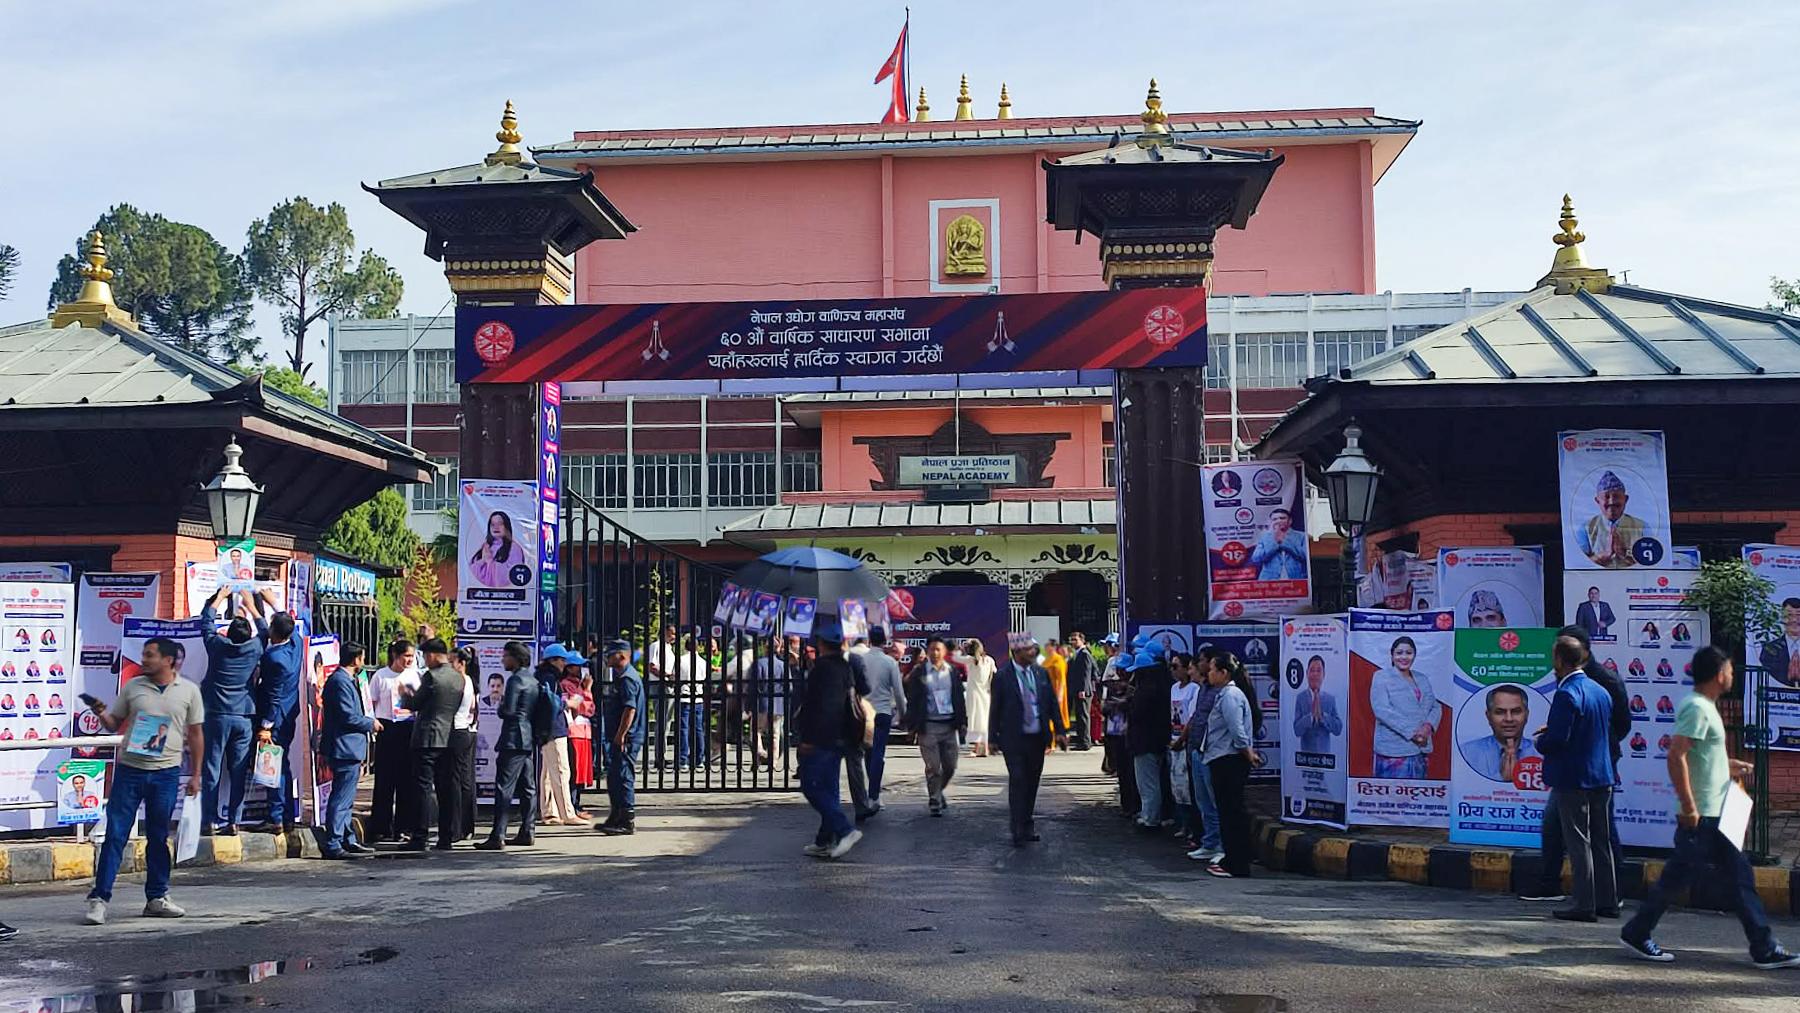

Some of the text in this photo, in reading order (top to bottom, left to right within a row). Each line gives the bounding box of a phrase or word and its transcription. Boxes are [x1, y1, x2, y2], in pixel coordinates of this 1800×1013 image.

[750, 307, 906, 323] नेपाल उद्योग वाणिज्य महासंघ
[720, 332, 742, 346] ६०
[768, 326, 816, 344] वार्षिक
[820, 328, 876, 342] साधारण
[880, 328, 930, 342] सभामा
[794, 348, 841, 368] हार्दिक
[845, 351, 896, 365] स्वागत
[922, 458, 948, 466] नेपाल
[922, 472, 1009, 480] NEPAL ACADEMY
[316, 564, 370, 593] epal Police
[1471, 666, 1486, 676] ६०
[1358, 782, 1389, 796] हिरा
[1458, 802, 1484, 818] प्रिय
[1488, 806, 1516, 819] राज
